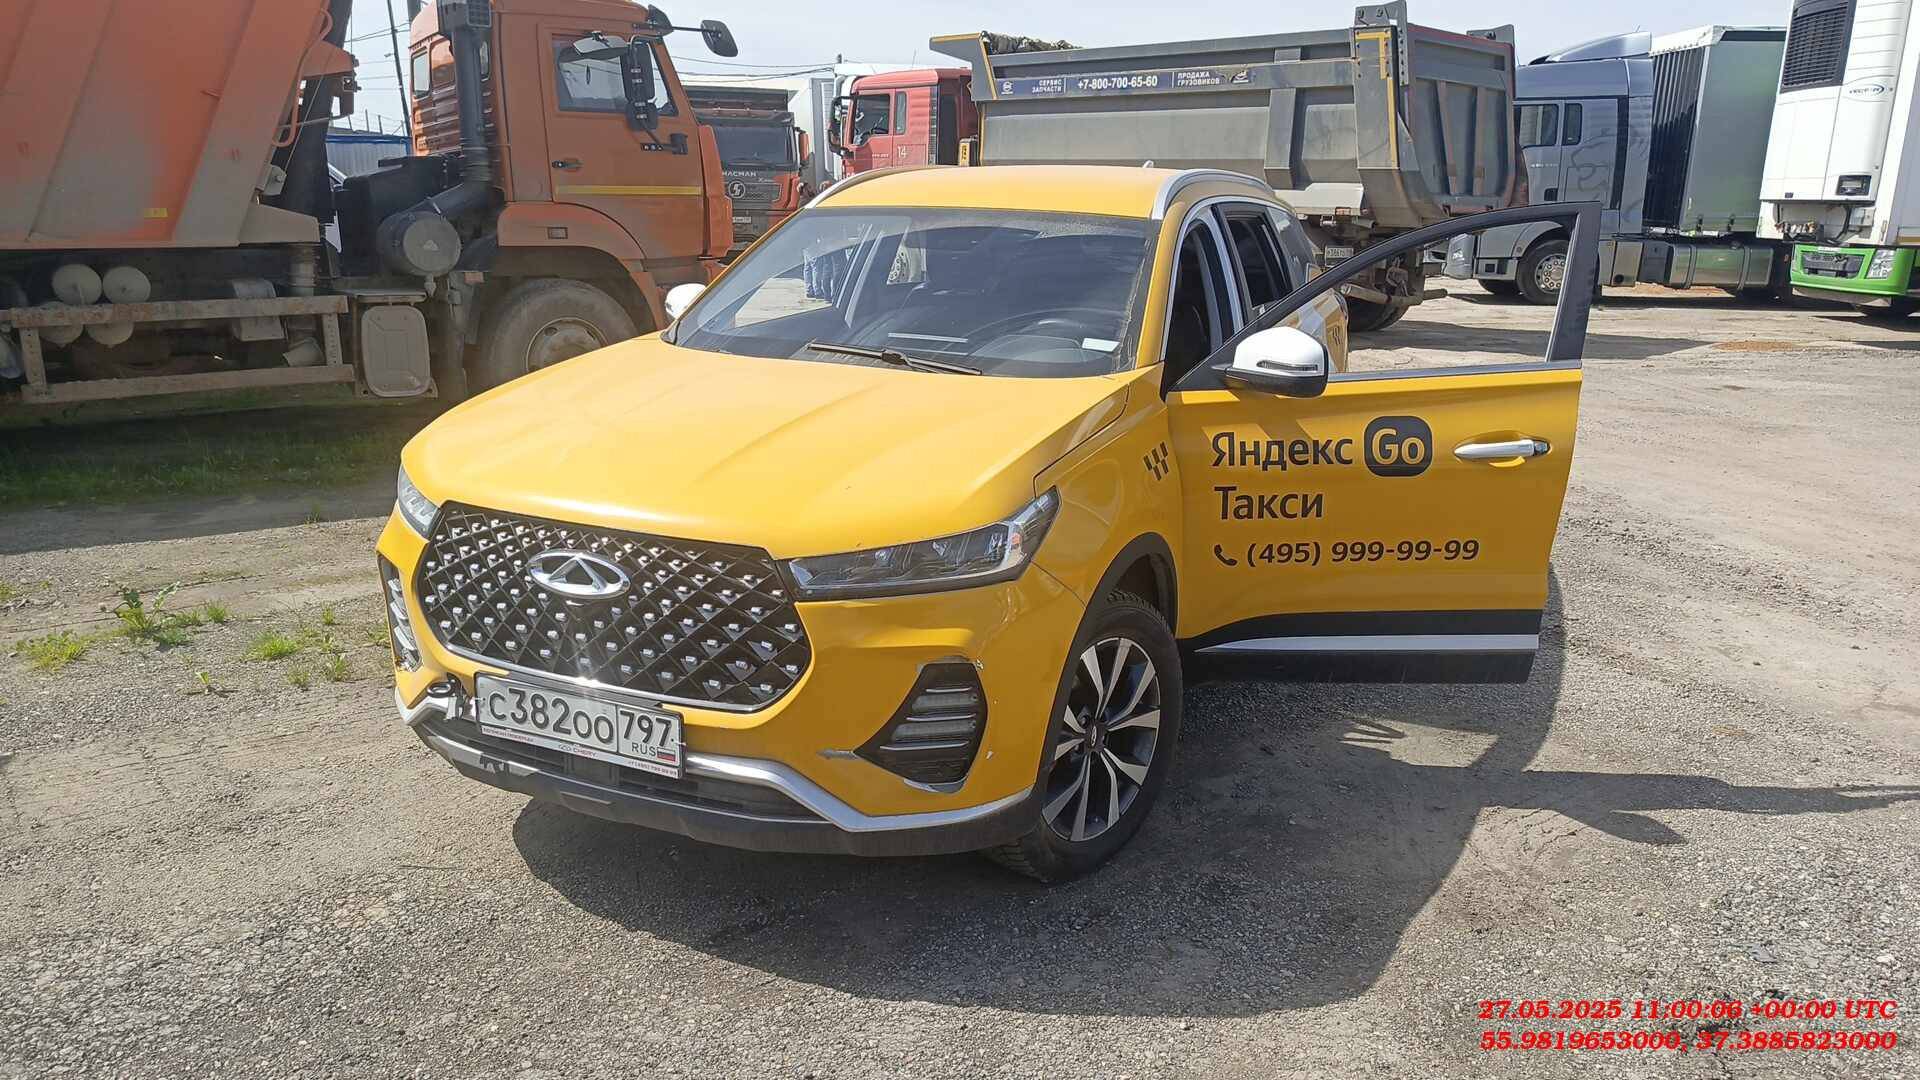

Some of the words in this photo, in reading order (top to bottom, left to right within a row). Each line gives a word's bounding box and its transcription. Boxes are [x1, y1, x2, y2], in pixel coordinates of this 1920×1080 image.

[1177, 71, 1210, 79] ПРОДАЖА
[1177, 77, 1220, 86] ГРУЗОВИКОВ
[1031, 86, 1062, 94] ЗАПЧАСТИ
[1038, 79, 1062, 87] СЕРВИС
[1078, 75, 1158, 91] +7-800-700-65-60
[897, 145, 907, 159] 14
[1211, 431, 1354, 472] Яндекс
[1371, 427, 1426, 465] Go
[1213, 485, 1325, 520] Такси
[1246, 541, 1322, 567] (495)
[1331, 539, 1480, 563] 999-99-99
[619, 709, 672, 747] 797
[631, 742, 657, 756] RUS
